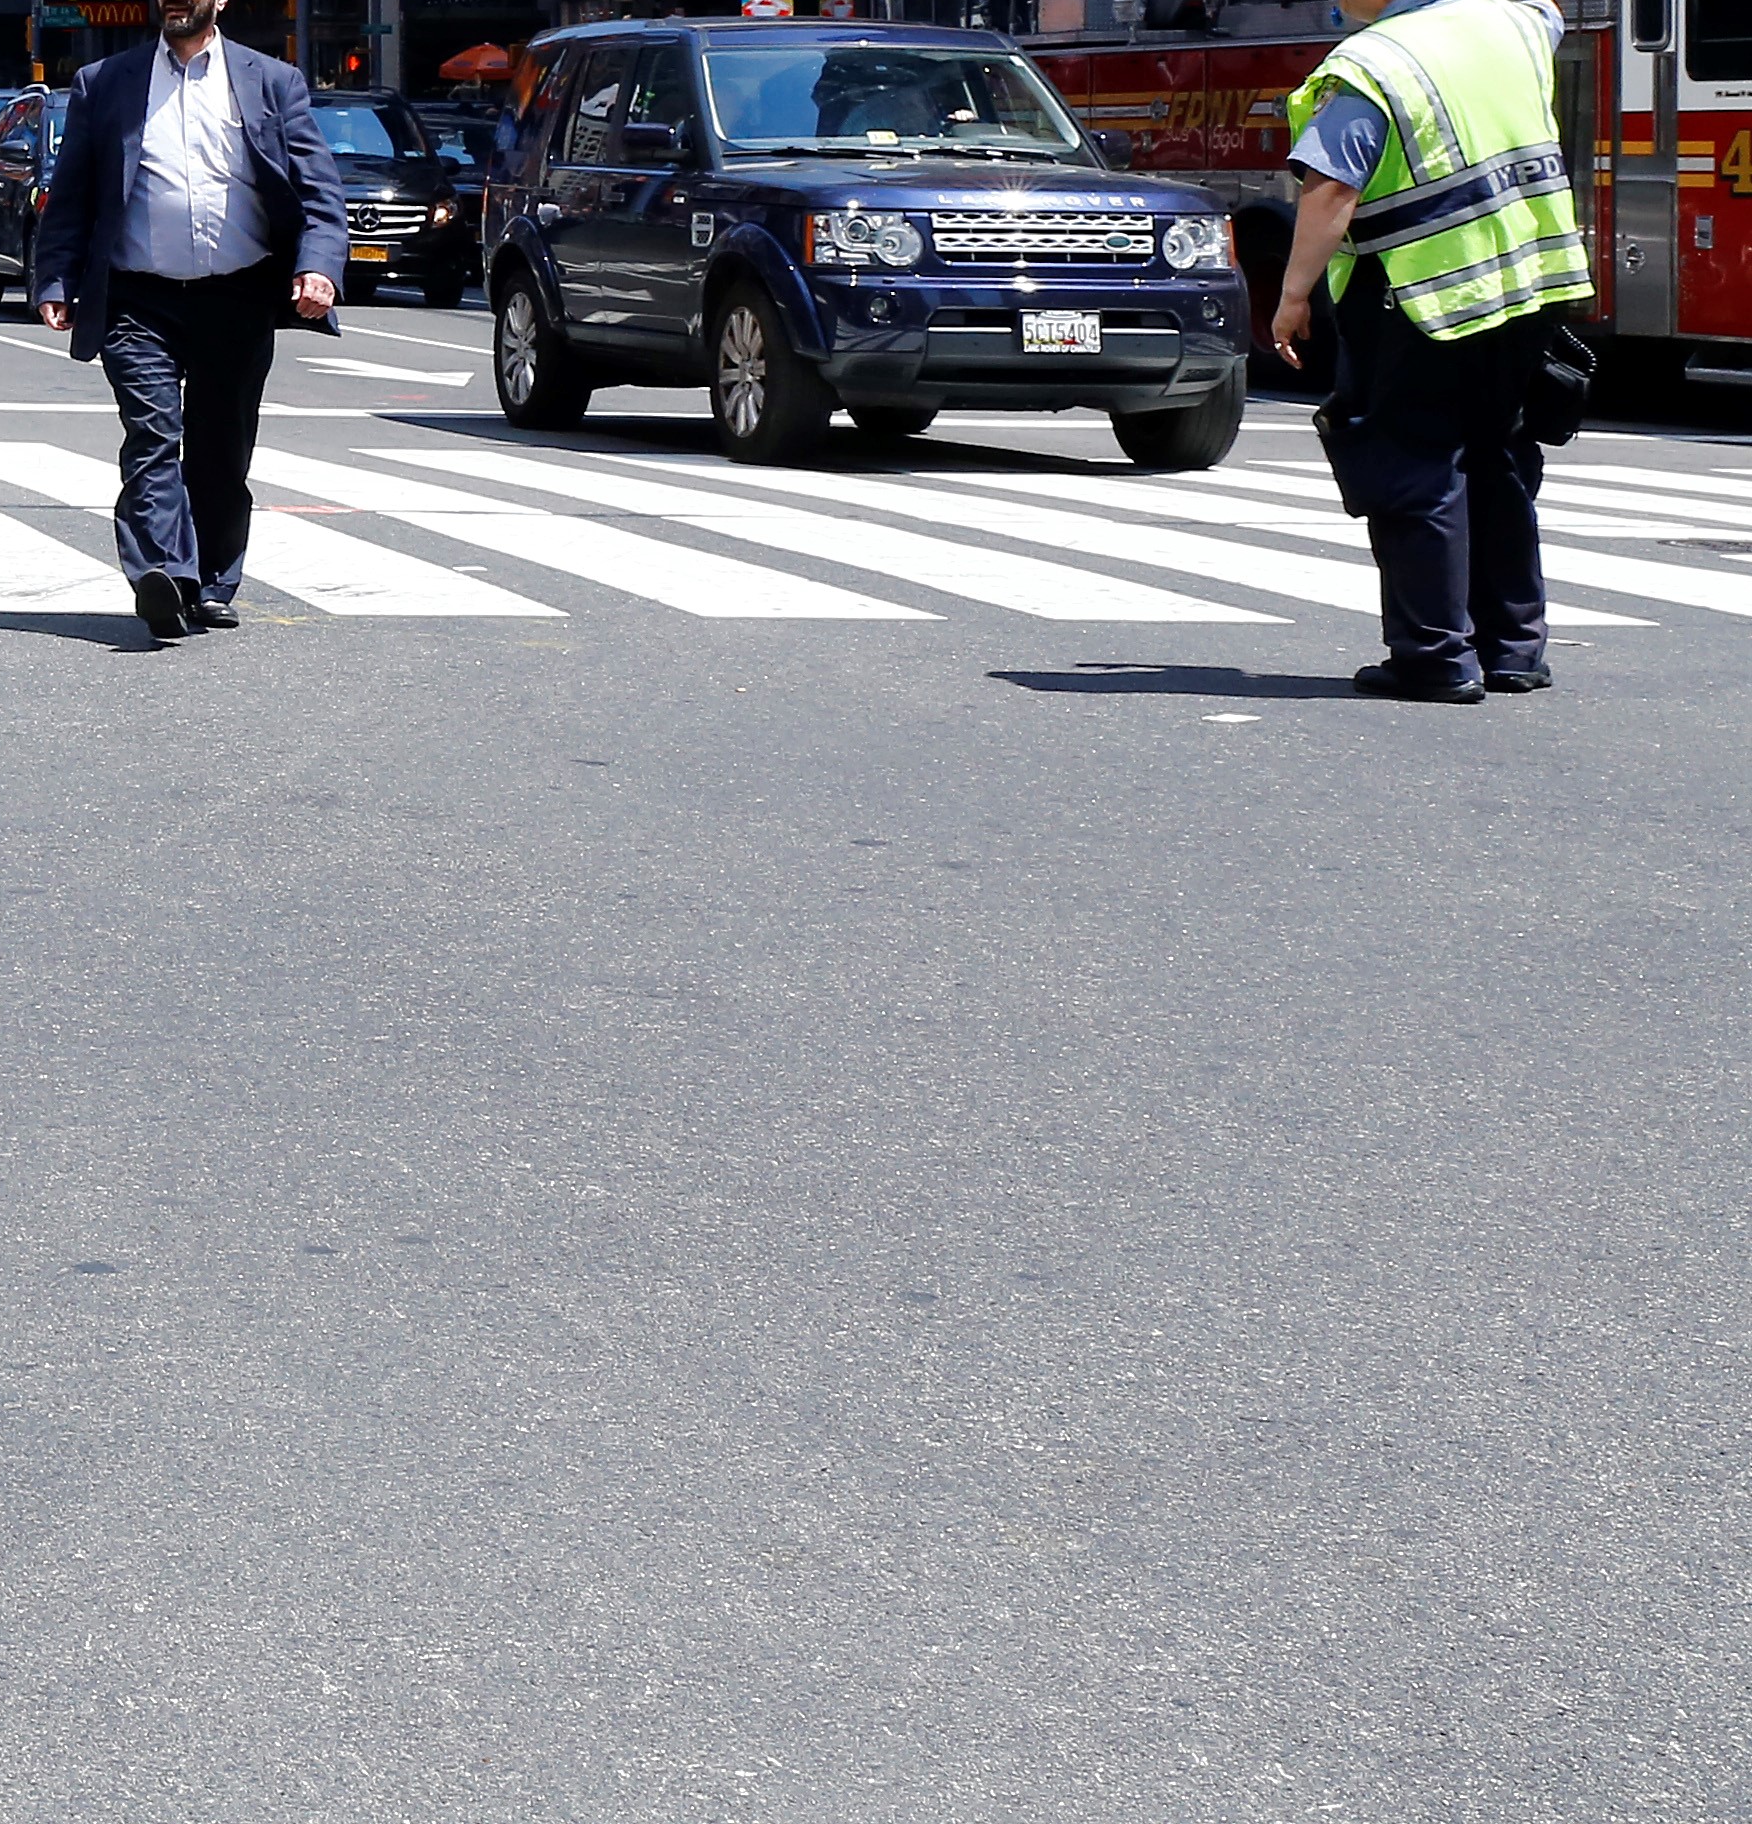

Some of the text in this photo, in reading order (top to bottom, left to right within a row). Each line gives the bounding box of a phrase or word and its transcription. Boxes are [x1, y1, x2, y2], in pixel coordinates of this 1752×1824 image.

[1167, 89, 1260, 129] FDNY
[1722, 130, 1752, 194] 4
[1024, 322, 1099, 343] 5CT5404
